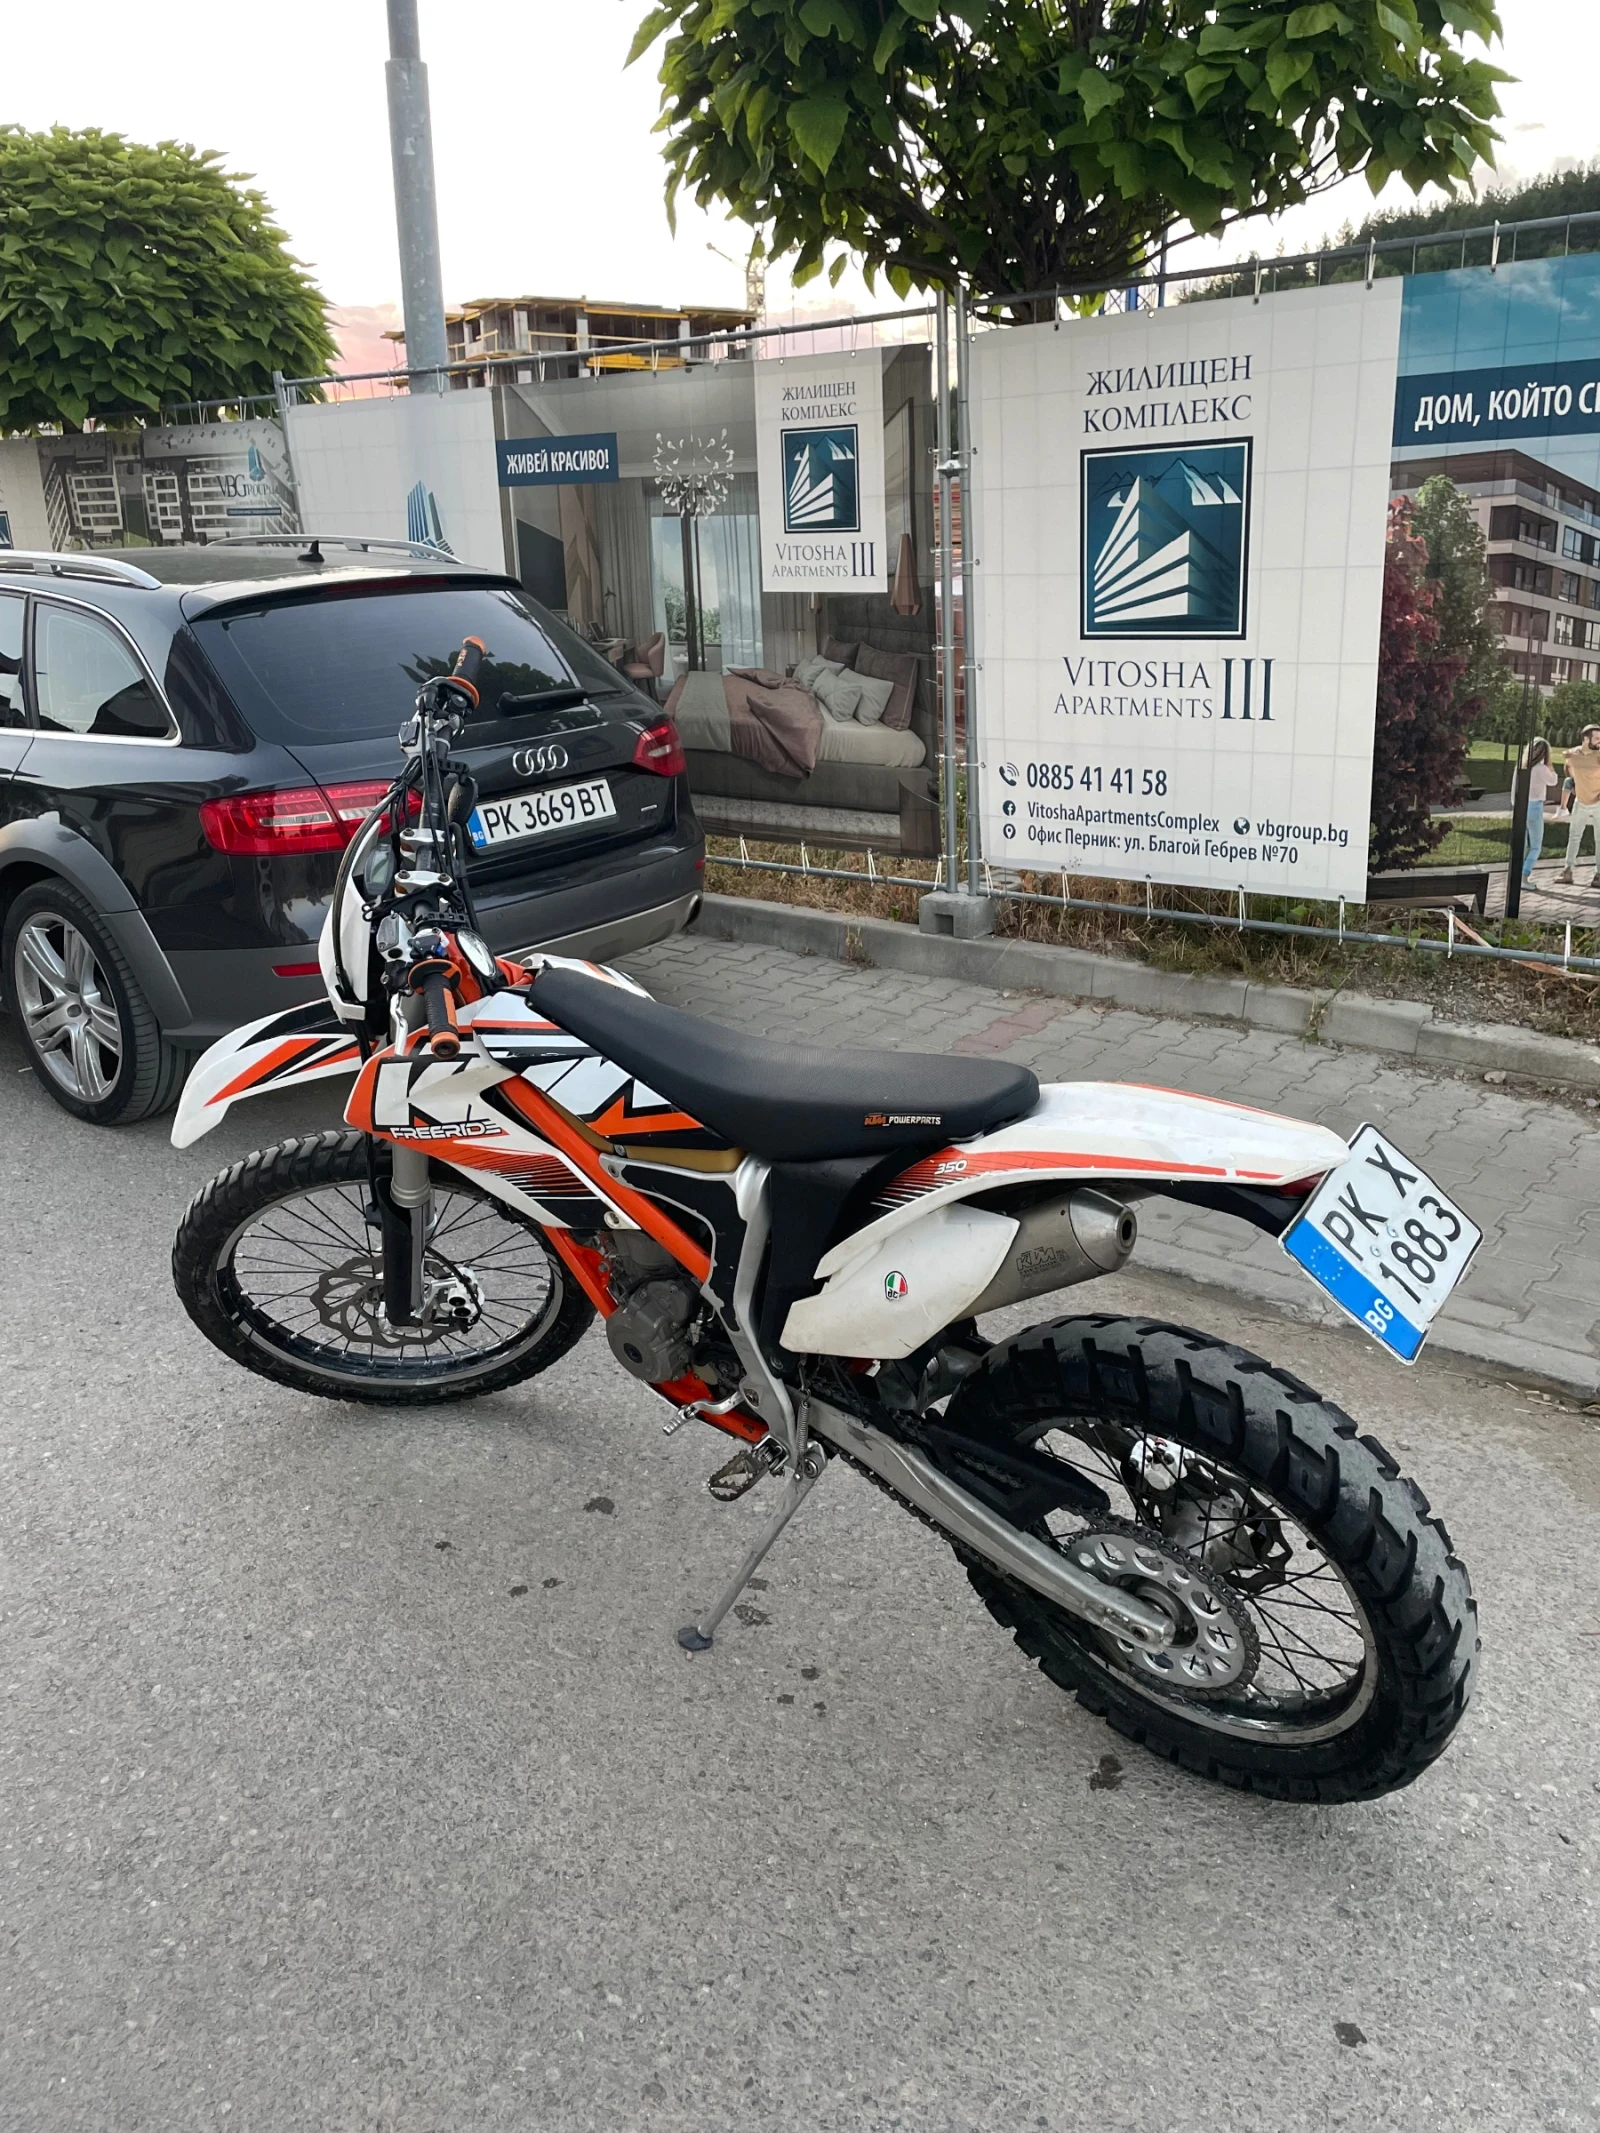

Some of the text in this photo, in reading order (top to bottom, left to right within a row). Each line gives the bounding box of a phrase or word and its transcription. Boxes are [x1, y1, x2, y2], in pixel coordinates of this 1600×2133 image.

[781, 381, 857, 402] ЖИЛИЩЕН
[1085, 355, 1252, 396] ЖИЛИЩЕН
[781, 401, 857, 422] КОМПЛЕКС
[1083, 394, 1252, 433] КОМПЛЕКС
[1414, 381, 1600, 432] ДОМ, КОЙТО С
[506, 448, 610, 474] ЖИВЕЙ КРАСИВО!
[850, 541, 876, 577] III
[1220, 657, 1276, 721] III
[1026, 762, 1168, 797] 0885 41 41 58
[483, 784, 608, 839] PK 3669 BT
[1027, 801, 1220, 833] VitoshaApartmentsComplex
[472, 831, 485, 841] BG
[1027, 825, 1299, 864] Офис Перник: ул. Благой Гебрев №70
[1256, 820, 1349, 848] vbgroup.bg
[390, 1121, 502, 1140] FREERIDE
[888, 1115, 941, 1126] POWERPARTS
[934, 1159, 968, 1175] 350
[1321, 1143, 1418, 1262] PK X
[1378, 1195, 1462, 1305] 1883
[1364, 1297, 1394, 1334] BG
